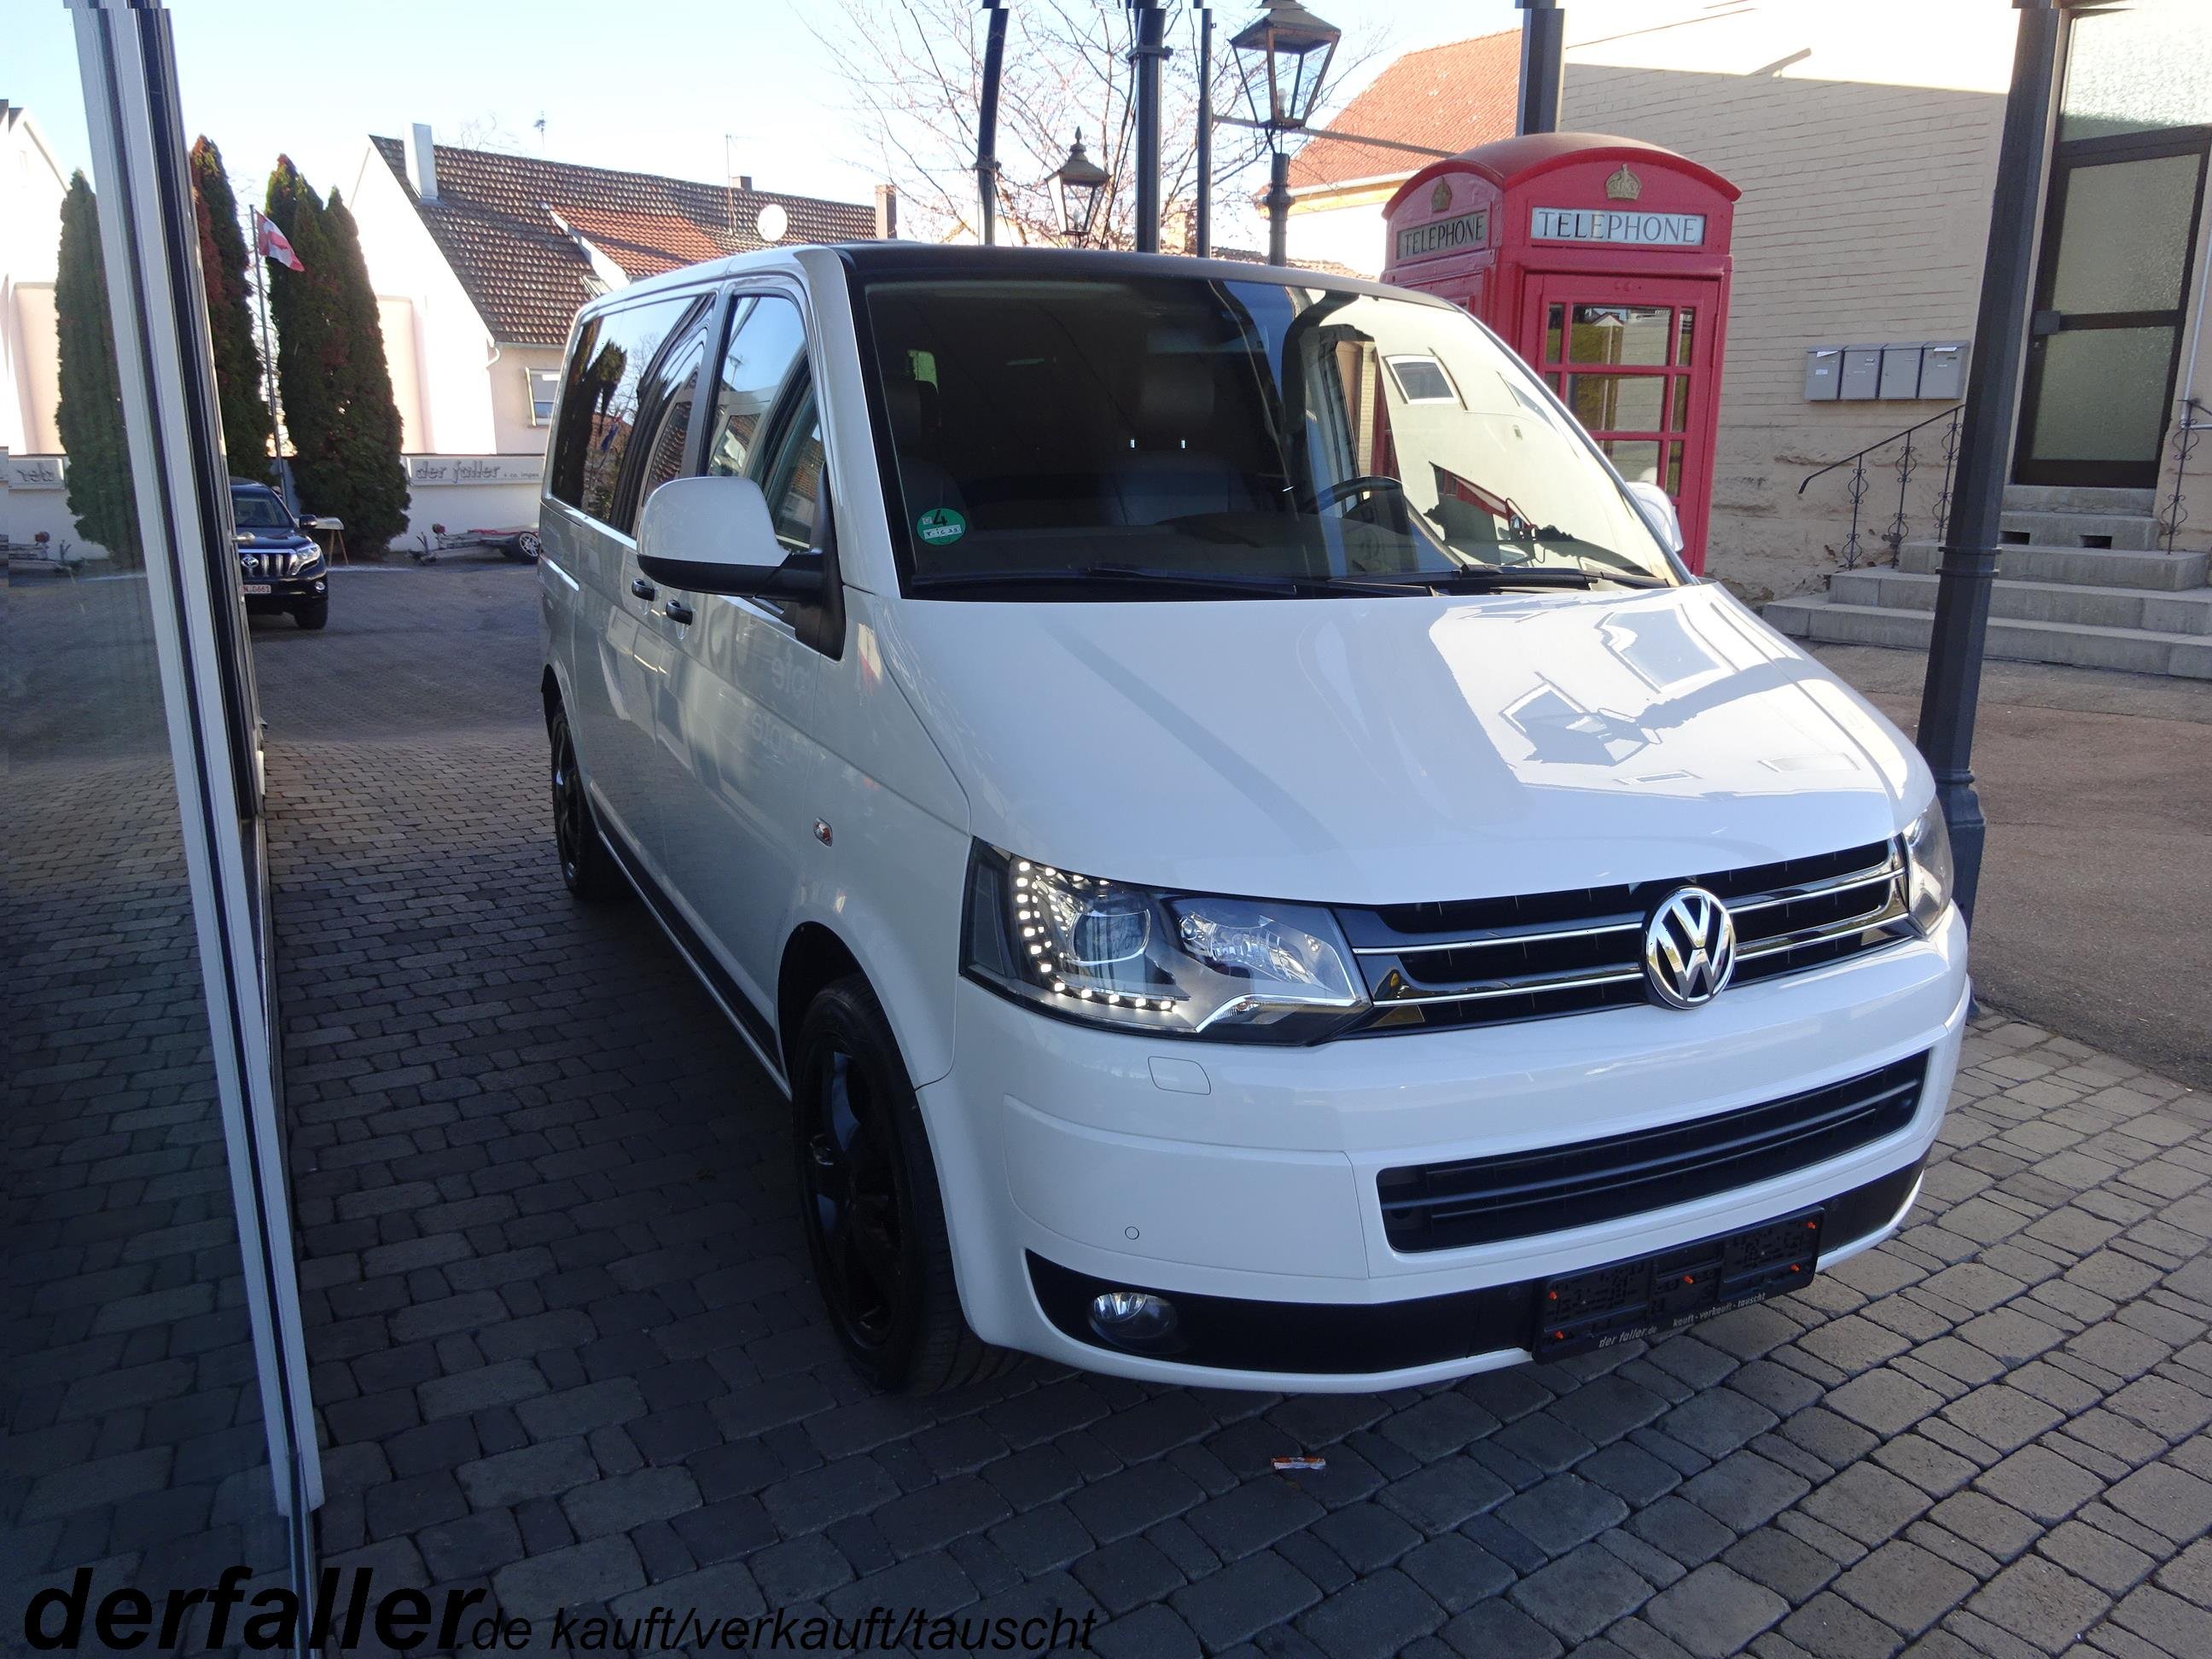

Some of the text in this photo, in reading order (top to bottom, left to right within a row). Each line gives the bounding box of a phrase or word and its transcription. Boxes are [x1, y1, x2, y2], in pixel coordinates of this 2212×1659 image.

[1405, 215, 1484, 256] TELEPHONE
[1539, 211, 1697, 242] TELEPHONE
[416, 460, 447, 479] der
[451, 460, 501, 484] faller
[933, 509, 947, 526] 4
[1646, 887, 1736, 1009] VW
[1598, 1335, 1617, 1348] der
